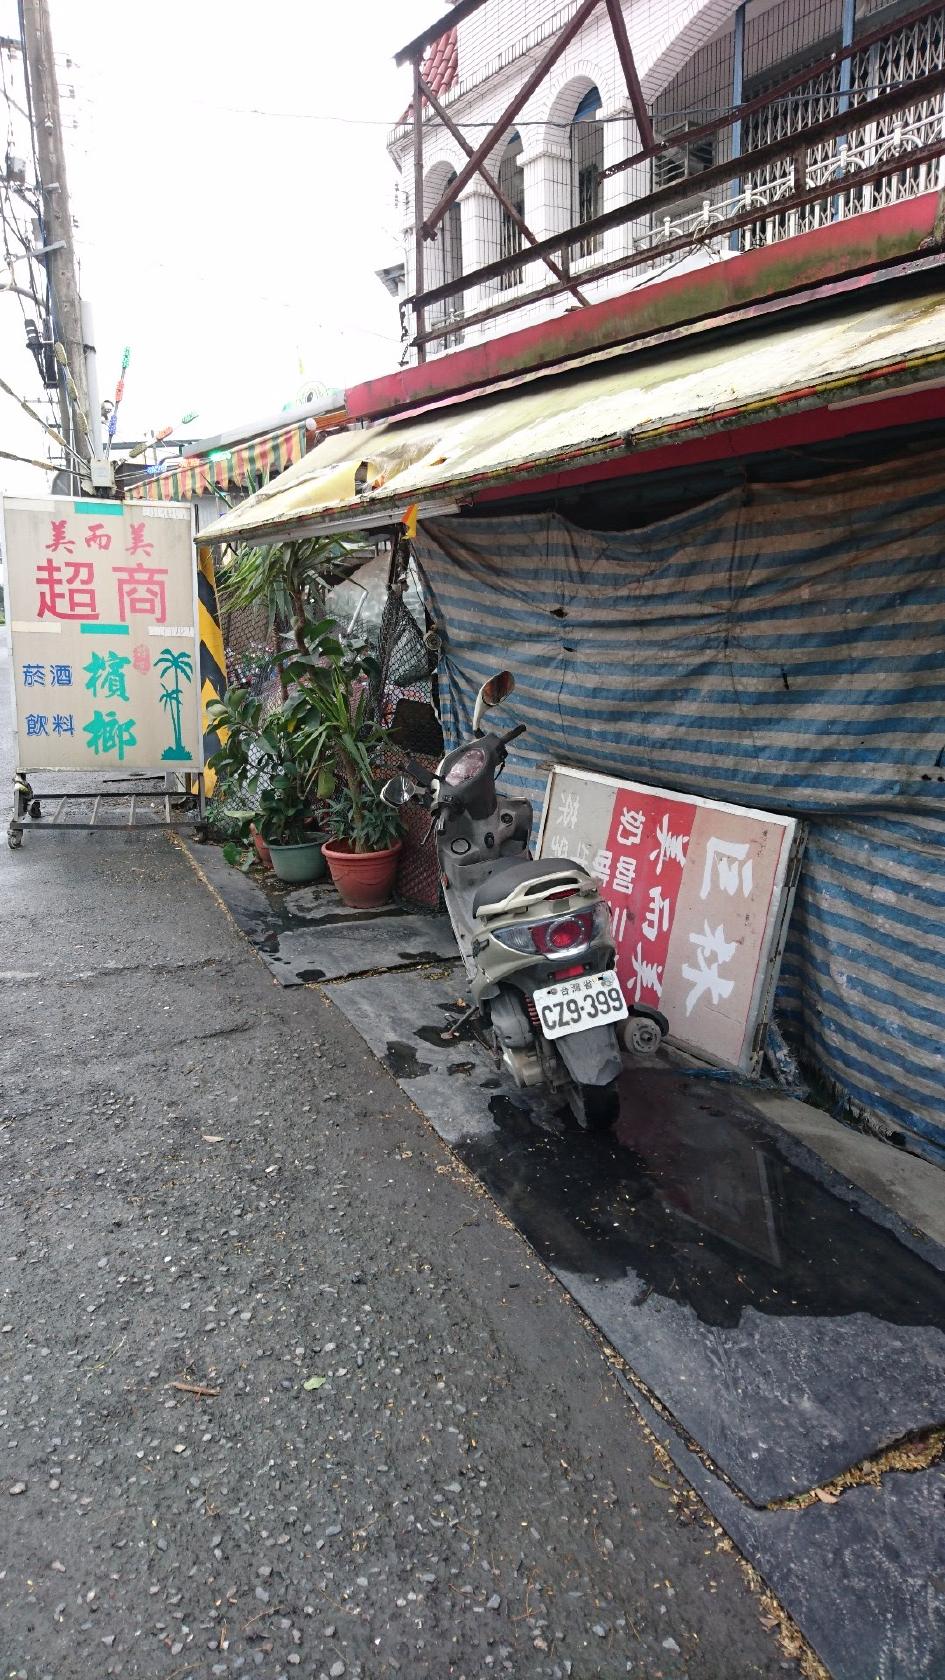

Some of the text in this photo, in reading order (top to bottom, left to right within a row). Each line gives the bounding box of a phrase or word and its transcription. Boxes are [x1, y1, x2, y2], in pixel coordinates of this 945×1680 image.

[45, 520, 155, 557] 美而美
[36, 558, 169, 624] 超商
[23, 664, 73, 687] 菸酒
[26, 713, 76, 737] 飲料
[626, 813, 690, 1003] 美而美
